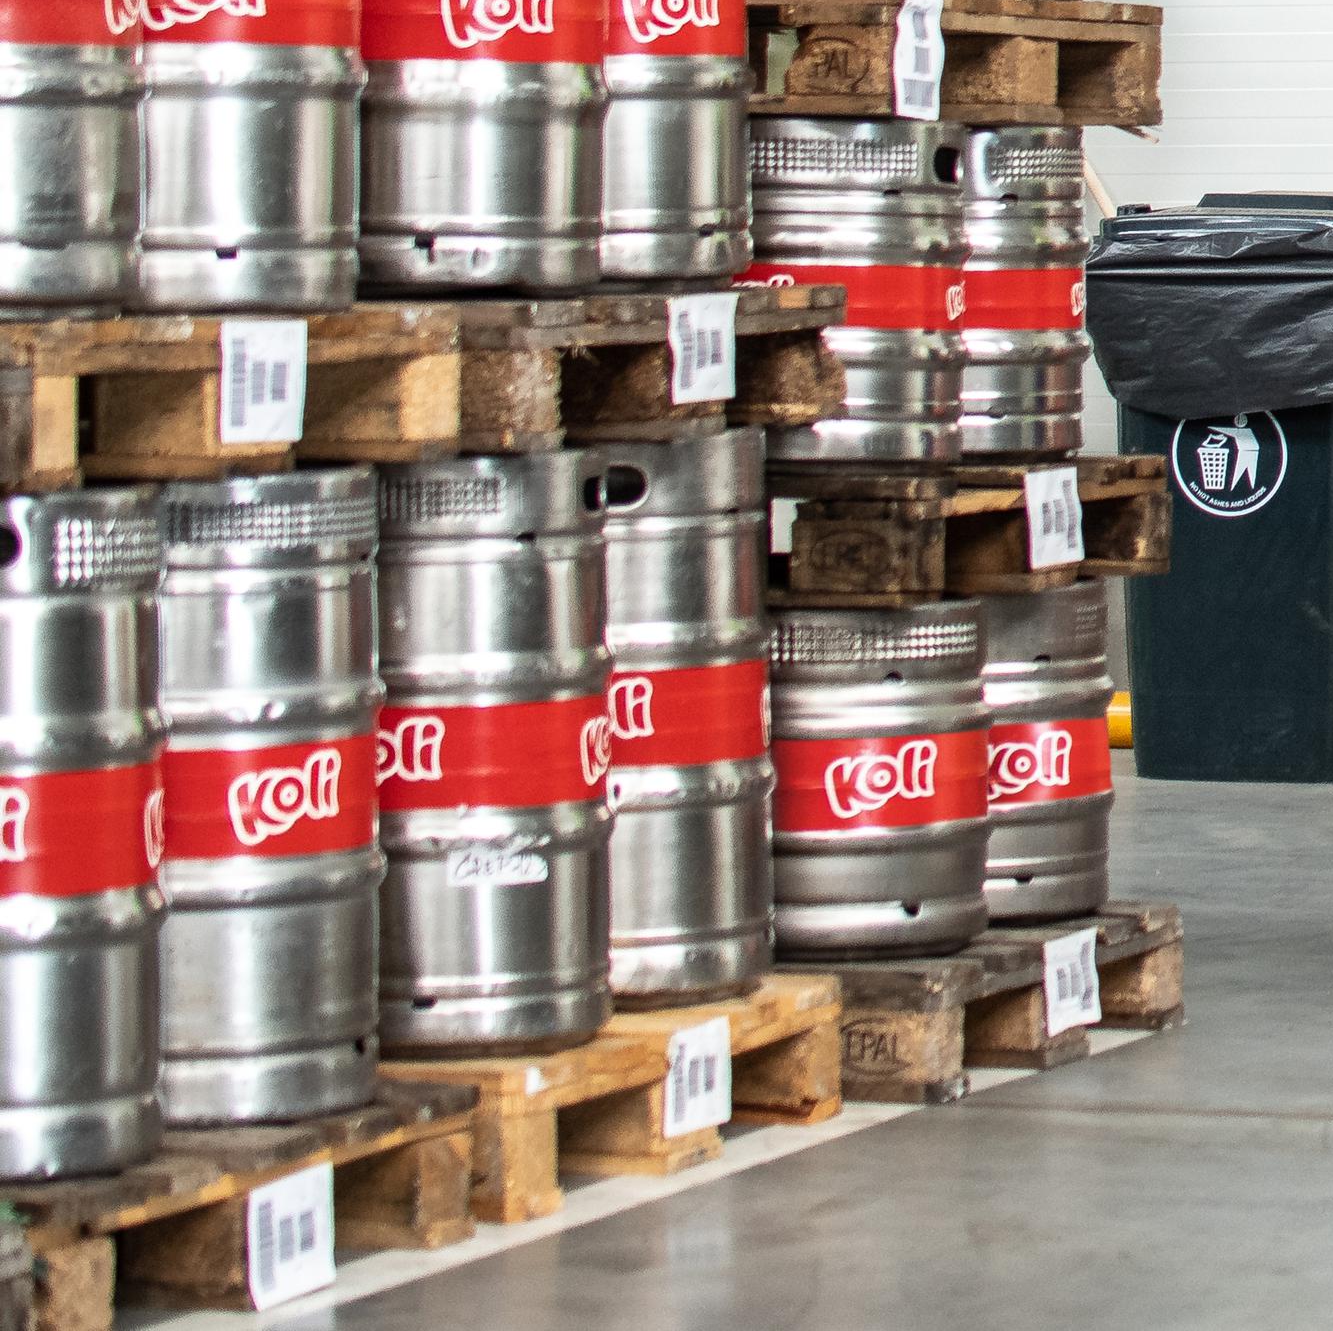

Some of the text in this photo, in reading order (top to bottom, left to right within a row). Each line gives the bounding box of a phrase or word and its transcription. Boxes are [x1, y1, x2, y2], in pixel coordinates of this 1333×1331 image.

[1189, 481, 1266, 508] NO HOT ASHES AND LIQUIDS
